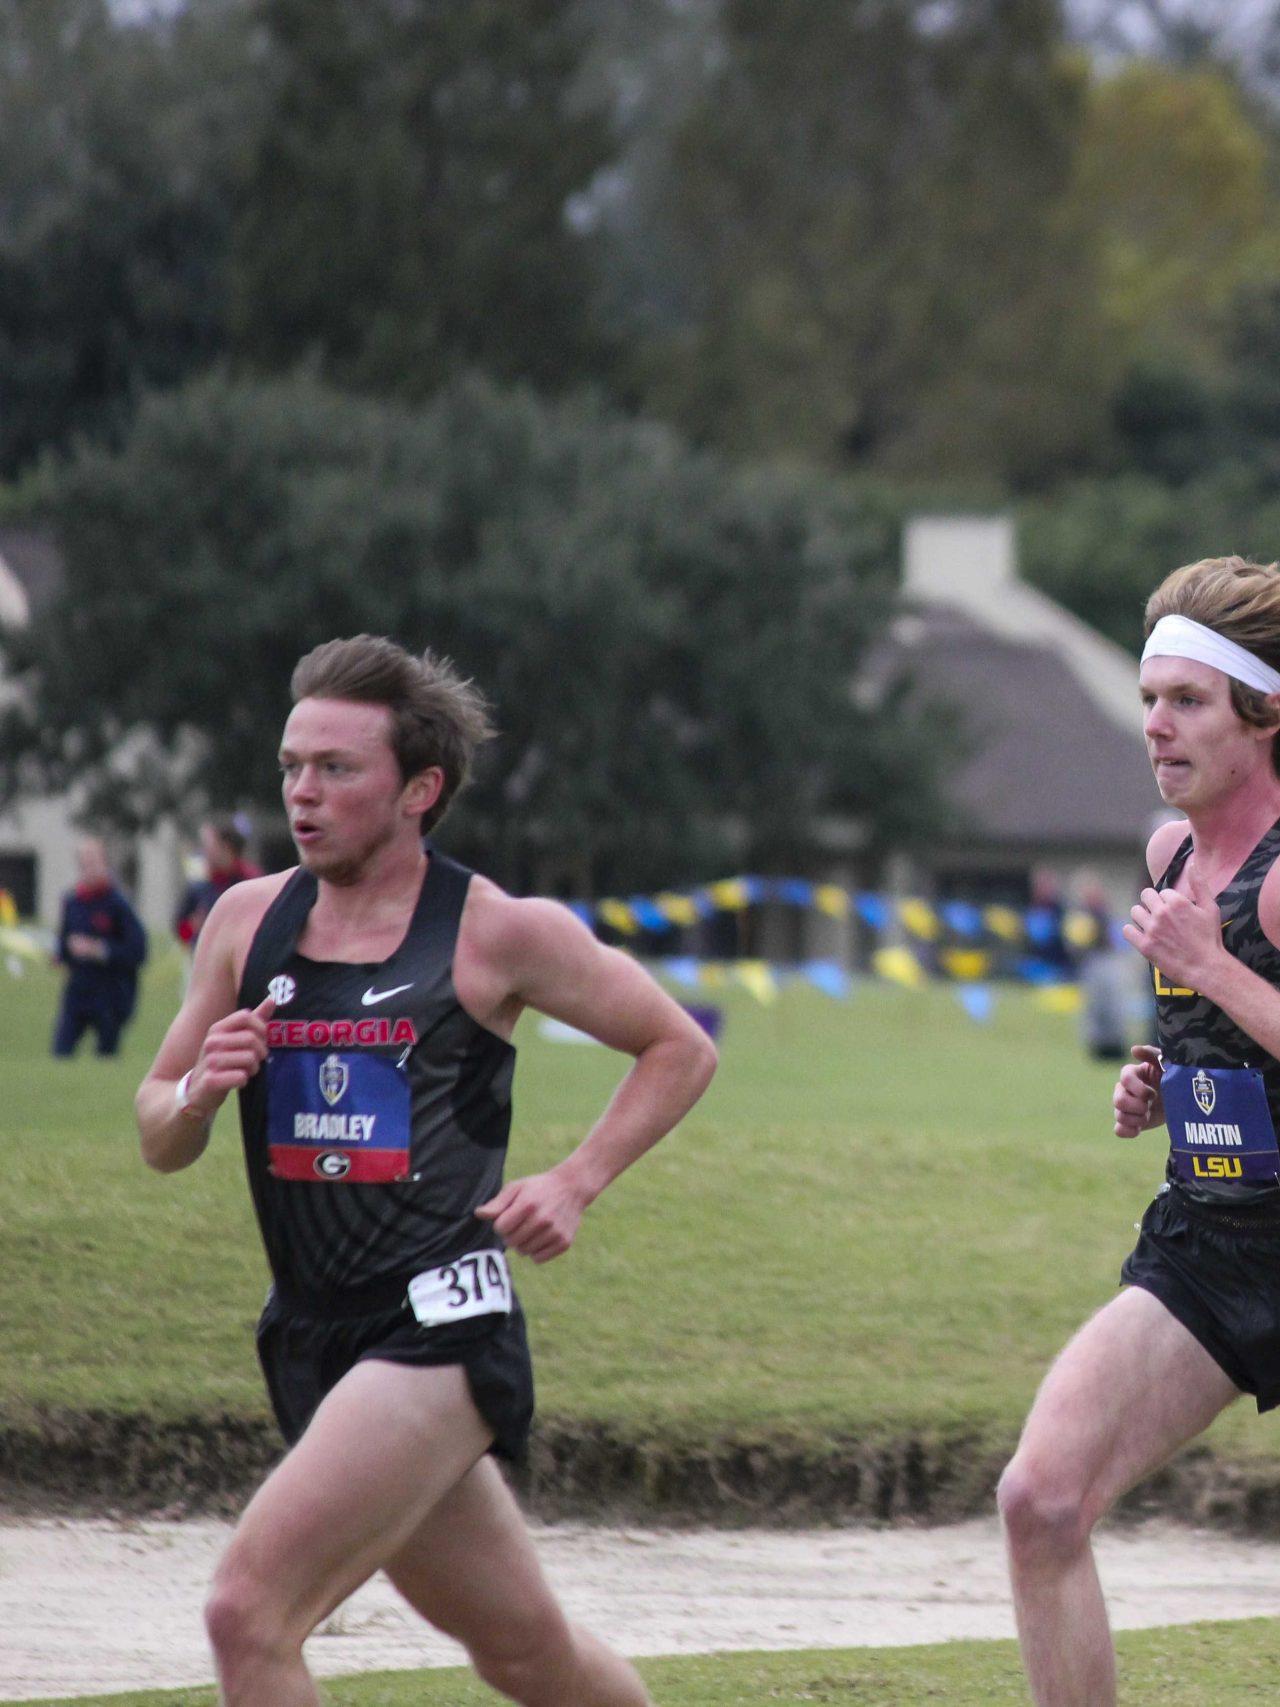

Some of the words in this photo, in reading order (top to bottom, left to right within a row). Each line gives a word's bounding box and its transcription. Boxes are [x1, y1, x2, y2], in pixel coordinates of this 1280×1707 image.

[266, 1017, 417, 1047] GEORGIA
[294, 1112, 376, 1141] BRADLEY
[1184, 1121, 1243, 1146] MARTIN
[1192, 1156, 1243, 1178] LSU
